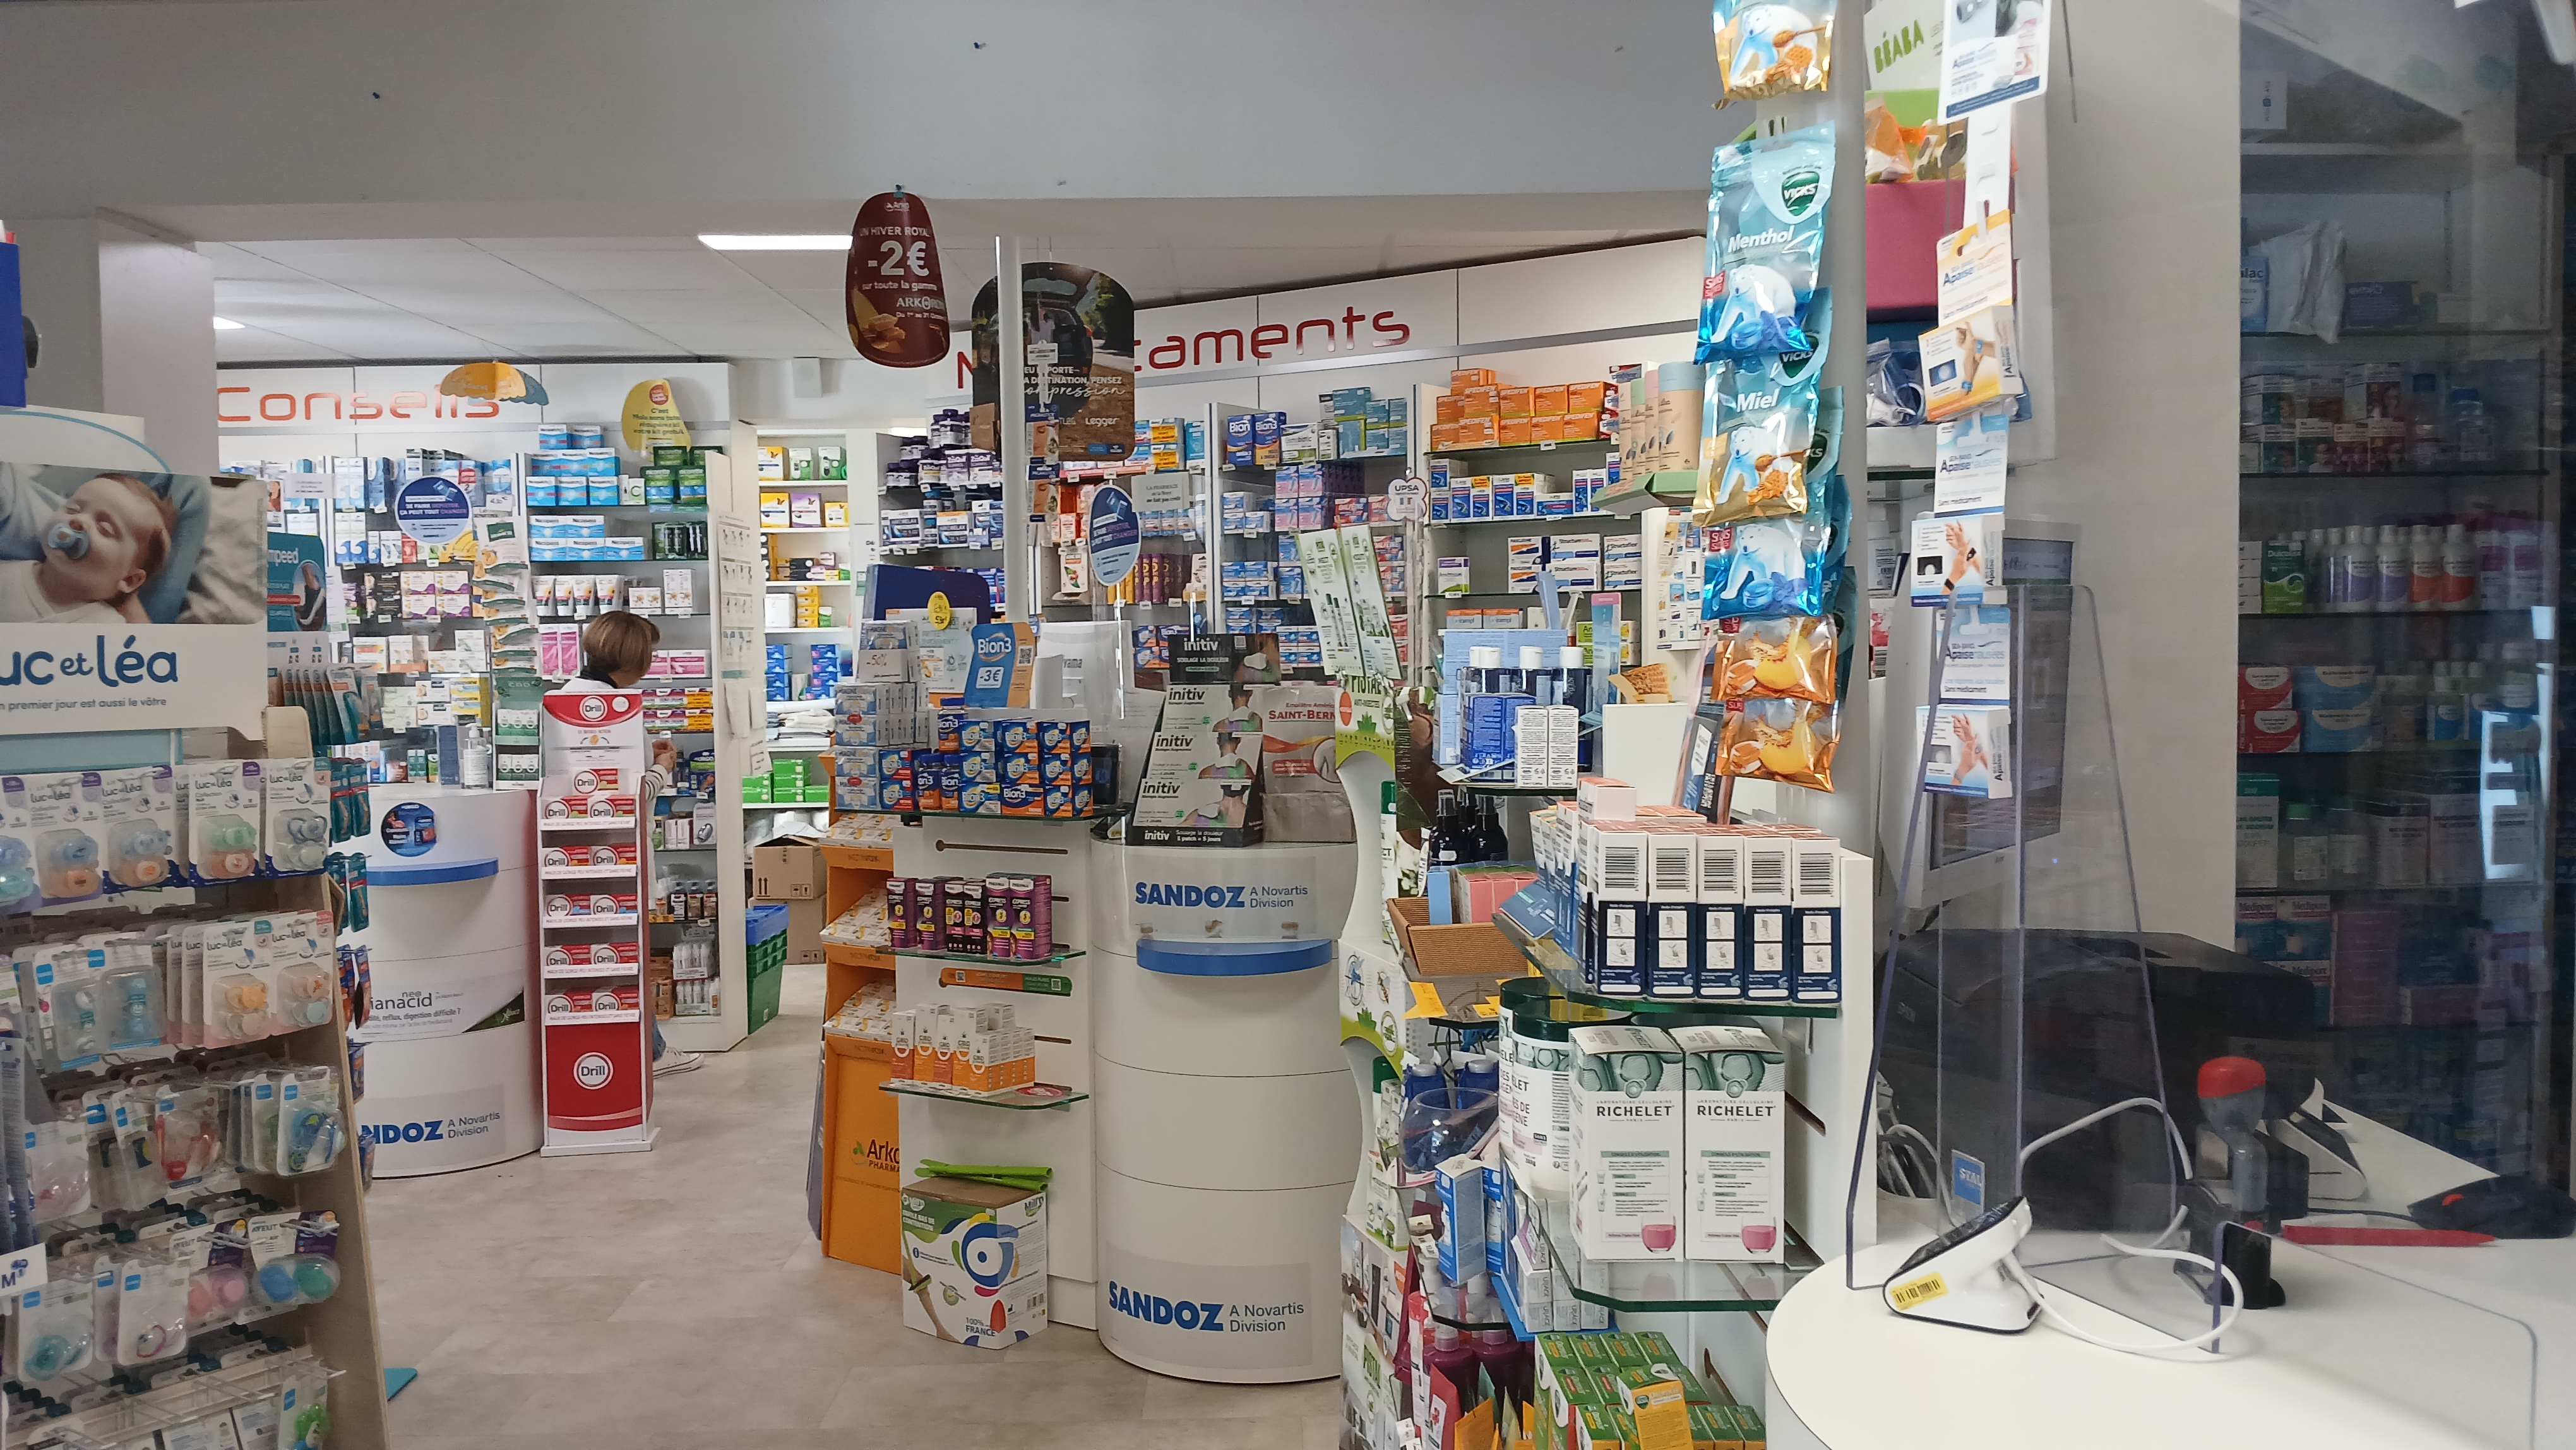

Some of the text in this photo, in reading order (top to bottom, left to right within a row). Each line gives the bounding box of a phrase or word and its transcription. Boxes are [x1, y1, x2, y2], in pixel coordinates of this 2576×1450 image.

[1873, 20, 1924, 73] BÉABA
[1784, 183, 1816, 199] VICKS
[871, 227, 902, 235] HIVER
[1727, 225, 1794, 253] Menthol
[874, 281, 898, 289] toute
[901, 280, 909, 289] la
[1781, 349, 1813, 363] VICKS
[1736, 392, 1779, 412] Miel
[1085, 417, 1119, 427] Legger
[1940, 458, 1971, 474] Apaise
[268, 547, 299, 564] mpeed
[977, 638, 1011, 654] Bion3
[59, 652, 93, 676] et
[97, 635, 177, 688] léa
[1169, 688, 1205, 700] initiv
[9, 696, 167, 711] premier jour est aussi le vôtre
[1269, 710, 1335, 720] SAINT-BERN
[1156, 734, 1193, 747] initiv
[578, 778, 595, 787] Drill
[1143, 781, 1180, 794] initiv
[548, 808, 566, 817] Drill
[593, 808, 611, 817] Drill
[1145, 830, 1170, 841] initiv
[596, 856, 614, 864] Drill
[1136, 882, 1308, 908] SANDOZ A Novartis
[1250, 897, 1294, 908] Division
[596, 905, 614, 913] Drill
[550, 957, 567, 966] Drill
[597, 955, 614, 963] Drill
[371, 992, 432, 1010] ianacid
[598, 1002, 616, 1010] Drill
[551, 1004, 568, 1012] Drill
[581, 1065, 606, 1077] Drill
[1597, 1106, 1673, 1117] RICHELET
[1697, 1106, 1773, 1117] RICHELET
[361, 1111, 501, 1144] NDOZ A Novartis
[448, 1125, 489, 1139] Division
[1109, 1281, 1304, 1332] SANDOZ A Novartis
[966, 1325, 996, 1337] FRANCE
[1229, 1317, 1287, 1333] Division
